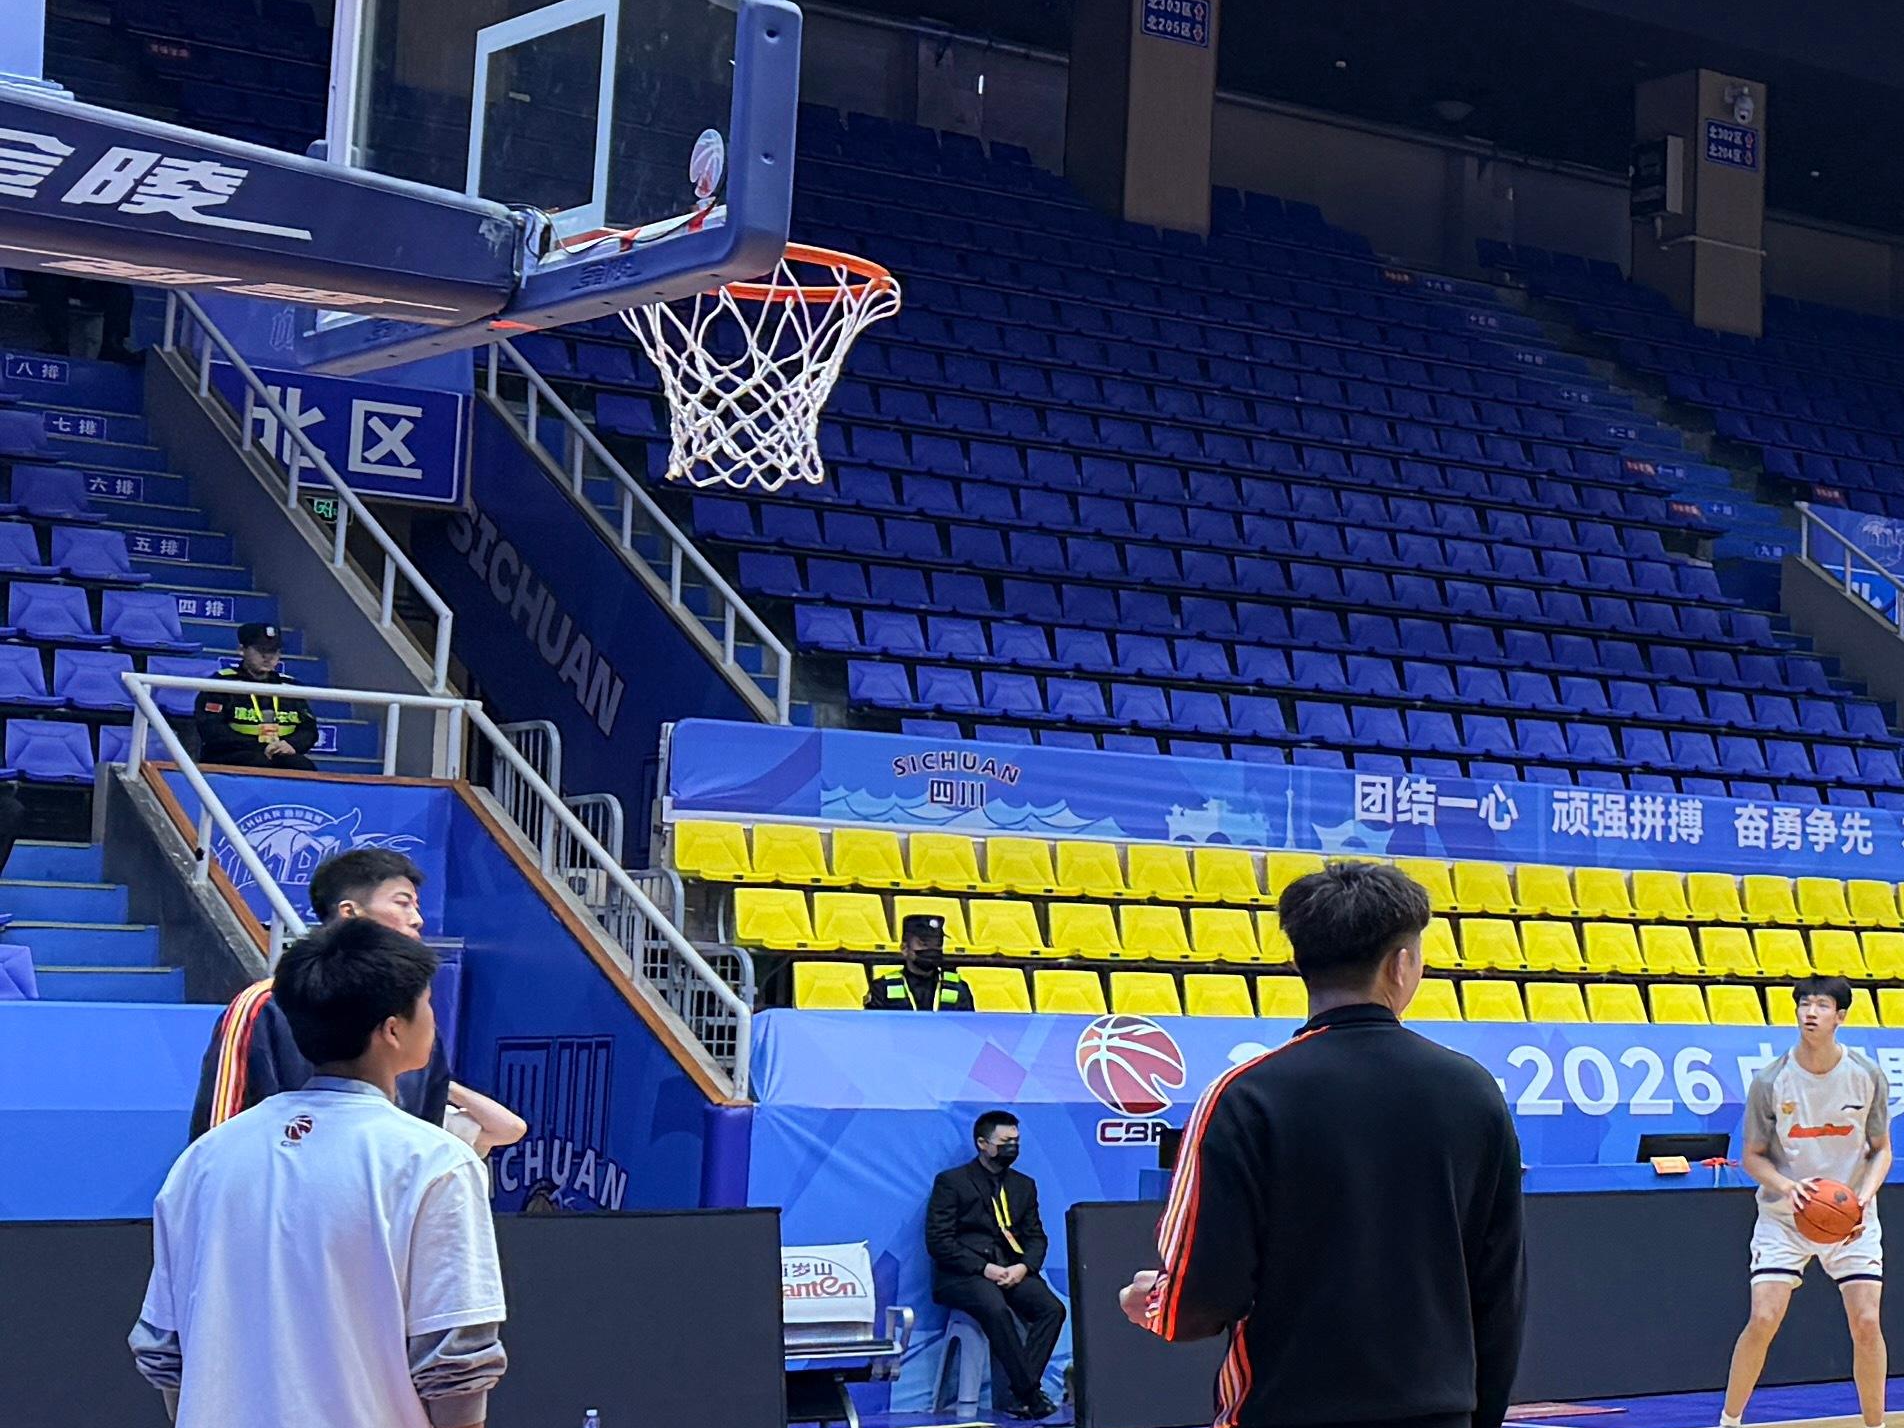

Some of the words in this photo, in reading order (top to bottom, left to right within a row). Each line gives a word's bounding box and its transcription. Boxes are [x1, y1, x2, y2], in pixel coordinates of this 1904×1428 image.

[16, 361, 60, 380] 八排
[52, 416, 97, 435] 七排
[88, 476, 134, 495] 六排
[133, 536, 179, 555] 五排
[178, 598, 225, 617] 四排
[447, 504, 626, 737] SICHUAN
[893, 750, 1021, 786] SICHUAN
[928, 778, 986, 809] 四川
[1353, 773, 1519, 832] 团结一心
[1551, 787, 1705, 845] 顽强拼搏
[1734, 802, 1874, 857] 奋勇争先
[487, 1138, 628, 1211] ICHUAN
[784, 1262, 833, 1278] 岁山
